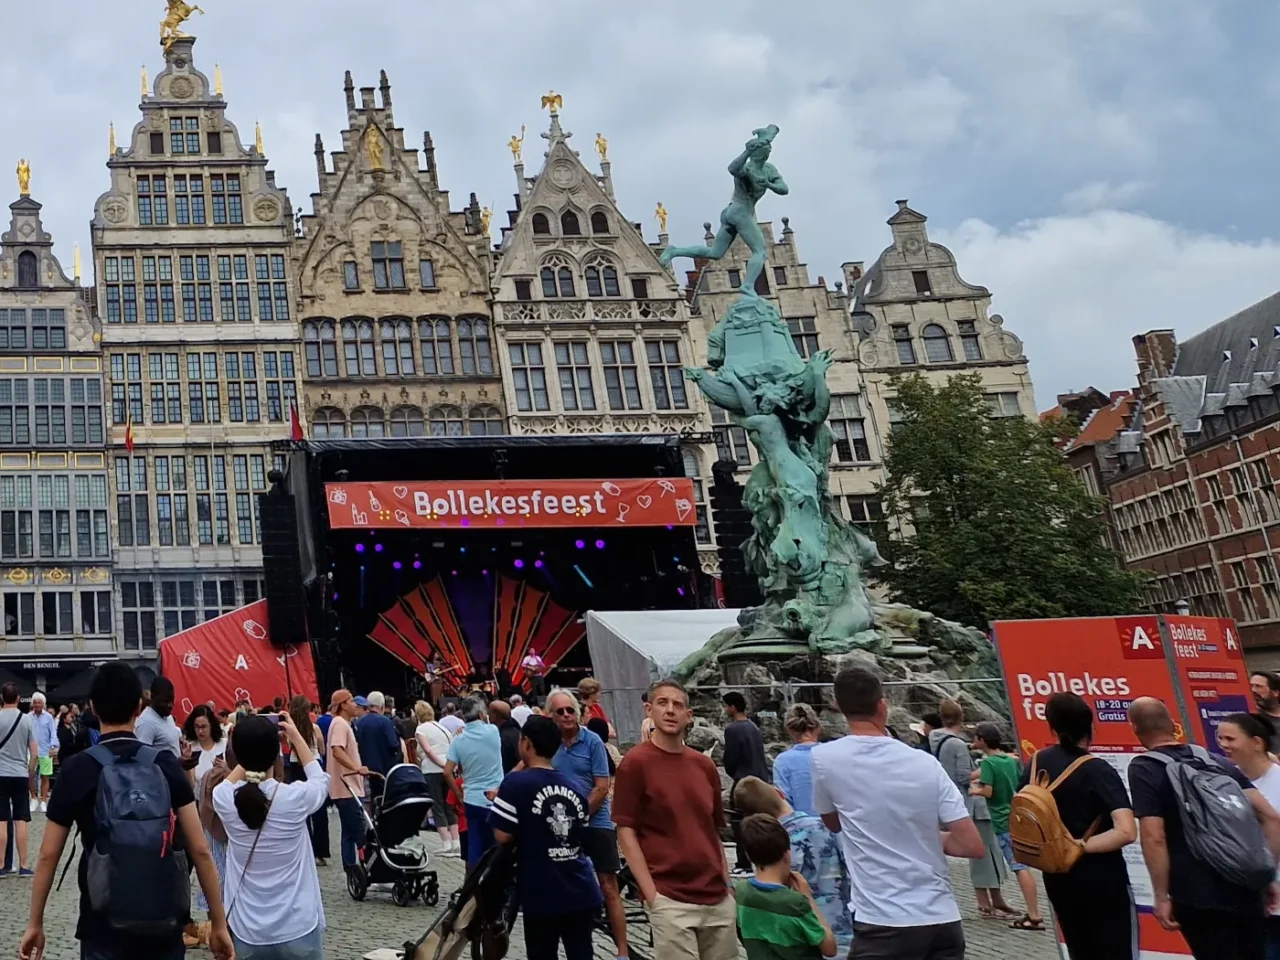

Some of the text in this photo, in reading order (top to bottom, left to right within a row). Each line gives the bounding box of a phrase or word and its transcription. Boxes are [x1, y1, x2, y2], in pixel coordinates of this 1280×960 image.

[413, 490, 607, 516] Bollekesfeest
[1132, 626, 1155, 650] A
[1169, 623, 1208, 641] Bollekes
[1226, 628, 1238, 651] A
[1174, 641, 1200, 658] feest
[235, 654, 249, 670] A
[1017, 671, 1131, 697] Bollekes
[1096, 699, 1121, 709] 18-20
[1098, 711, 1126, 721] Gratis
[531, 785, 585, 819] SAN FRANCISCO
